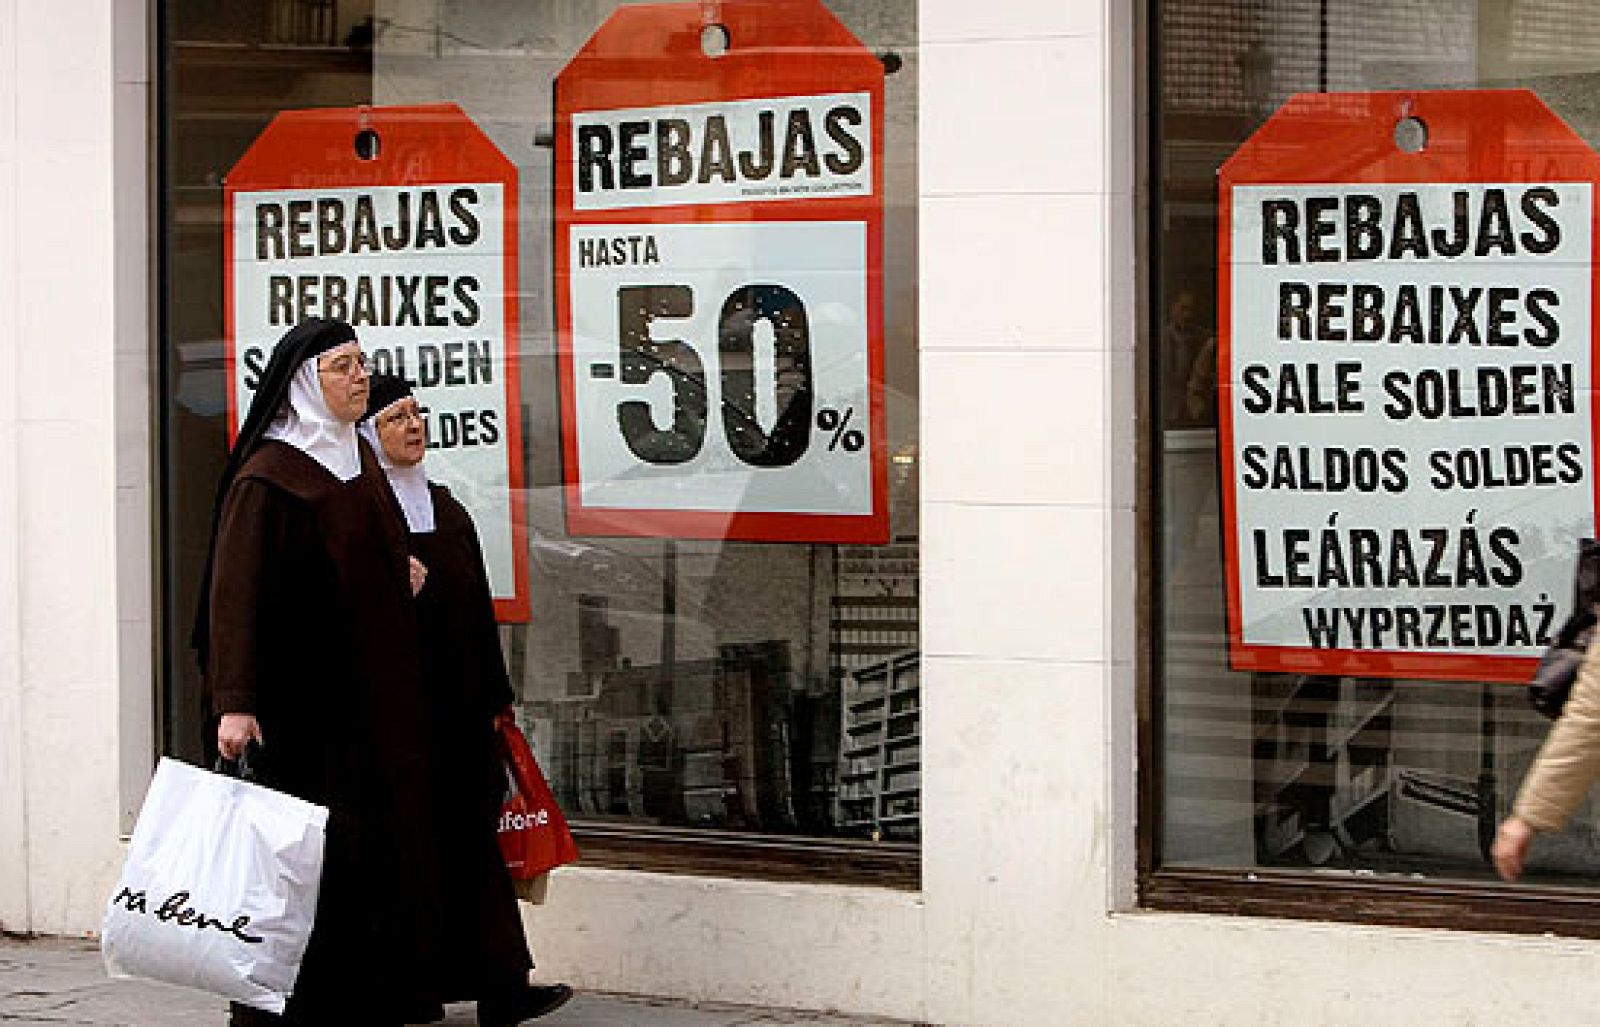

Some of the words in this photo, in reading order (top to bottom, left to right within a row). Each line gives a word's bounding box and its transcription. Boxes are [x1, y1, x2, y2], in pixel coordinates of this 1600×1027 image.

[578, 105, 865, 193] REBAJAS
[256, 188, 480, 260] REBAJAS
[578, 235, 661, 268] HASTA
[1262, 187, 1562, 265] REBAJAS
[269, 275, 481, 327] REBAIXES
[1278, 282, 1560, 347] REBAIXES
[364, 340, 493, 388] OLDEN
[1242, 362, 1364, 414] SALE
[1383, 363, 1575, 419] SOLDEN
[424, 409, 499, 449] LDES
[1243, 445, 1408, 492] SALDOS
[1429, 444, 1583, 489] SOLDES
[1253, 508, 1523, 588] LEÁRAZÁS
[1303, 593, 1556, 649] WYPRZEDAŻ
